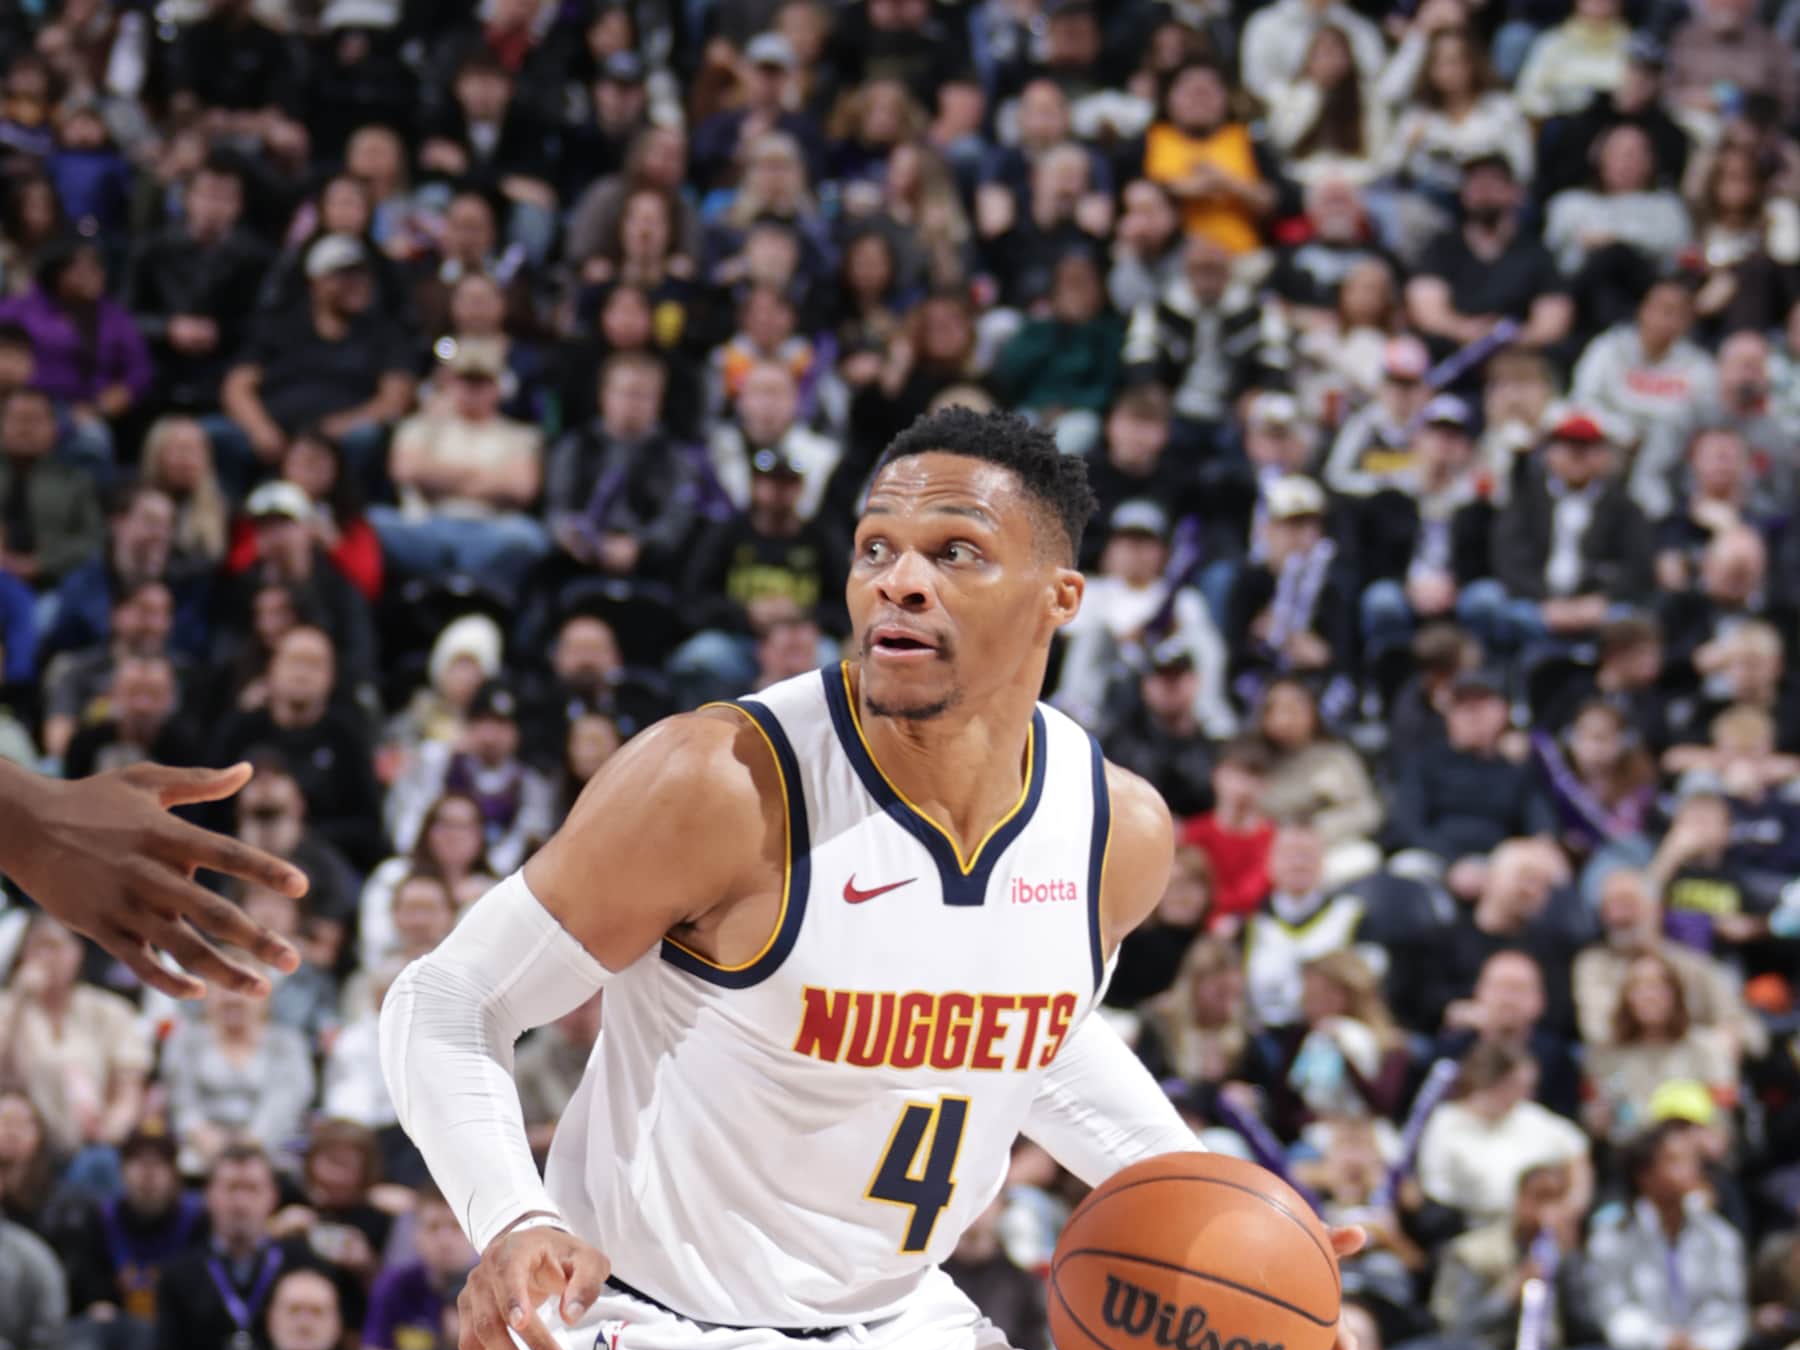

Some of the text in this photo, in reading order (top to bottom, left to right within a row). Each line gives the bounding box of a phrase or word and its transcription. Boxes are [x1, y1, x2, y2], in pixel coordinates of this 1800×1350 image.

[1011, 878, 1078, 904] ibotta
[792, 984, 1078, 1072] NUGGETS
[863, 1093, 972, 1256] 4
